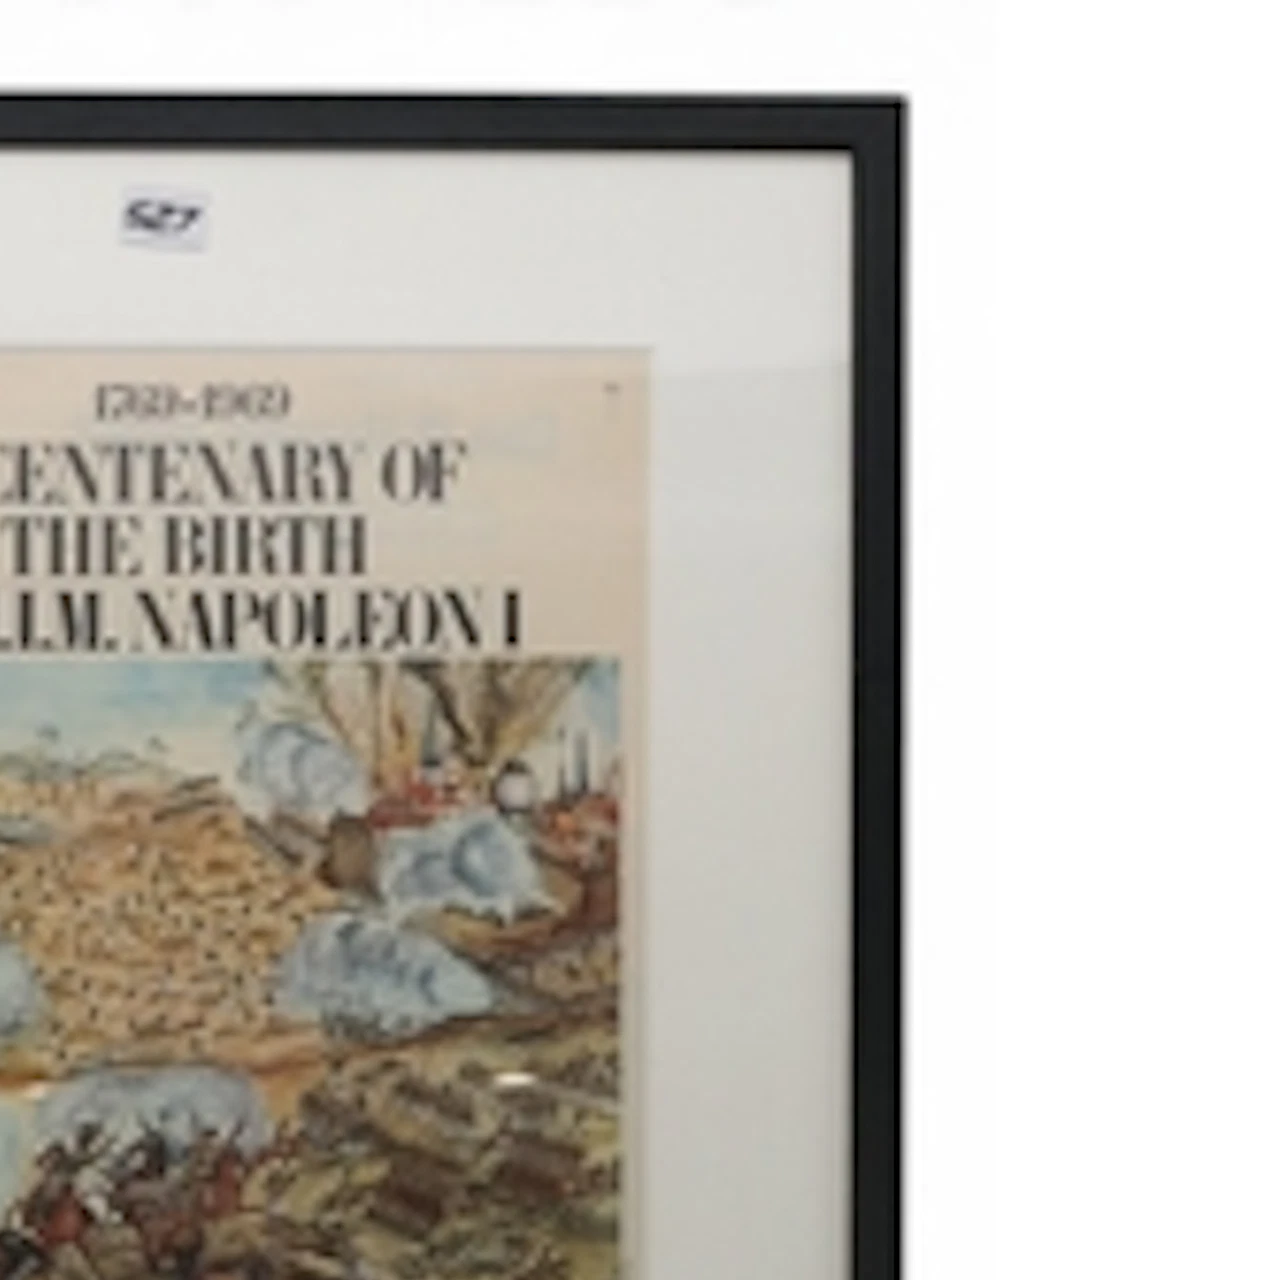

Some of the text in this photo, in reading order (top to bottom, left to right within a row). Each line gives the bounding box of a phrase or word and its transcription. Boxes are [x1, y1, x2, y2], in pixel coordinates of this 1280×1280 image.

[125, 199, 203, 234] 527
[379, 443, 468, 505] OF
[0, 515, 368, 577] THE BIRTH
[131, 590, 484, 652] NAPOLEON
[501, 590, 524, 650] I
